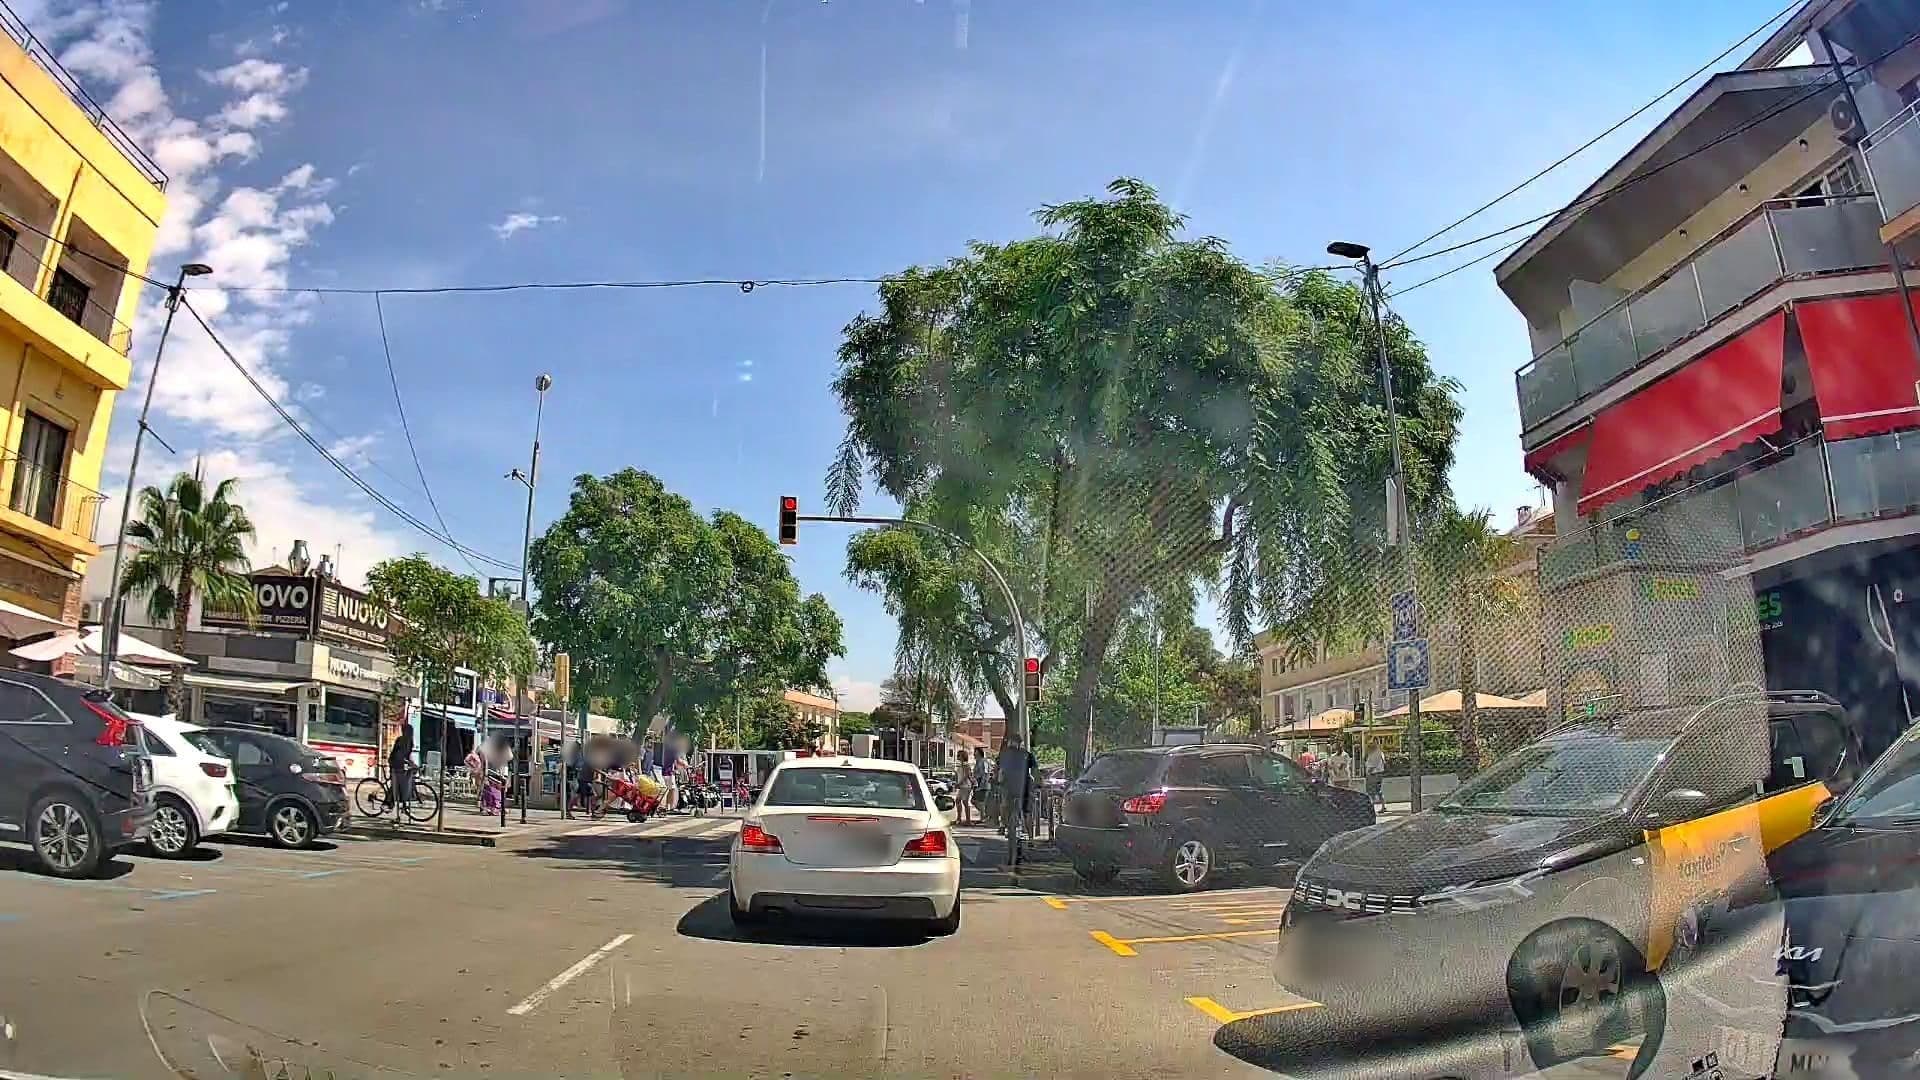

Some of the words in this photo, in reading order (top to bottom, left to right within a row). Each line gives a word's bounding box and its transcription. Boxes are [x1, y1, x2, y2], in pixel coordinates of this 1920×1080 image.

[338, 594, 388, 630] NUOVO
[329, 657, 360, 676] NUOVO
[1395, 646, 1421, 684] P
